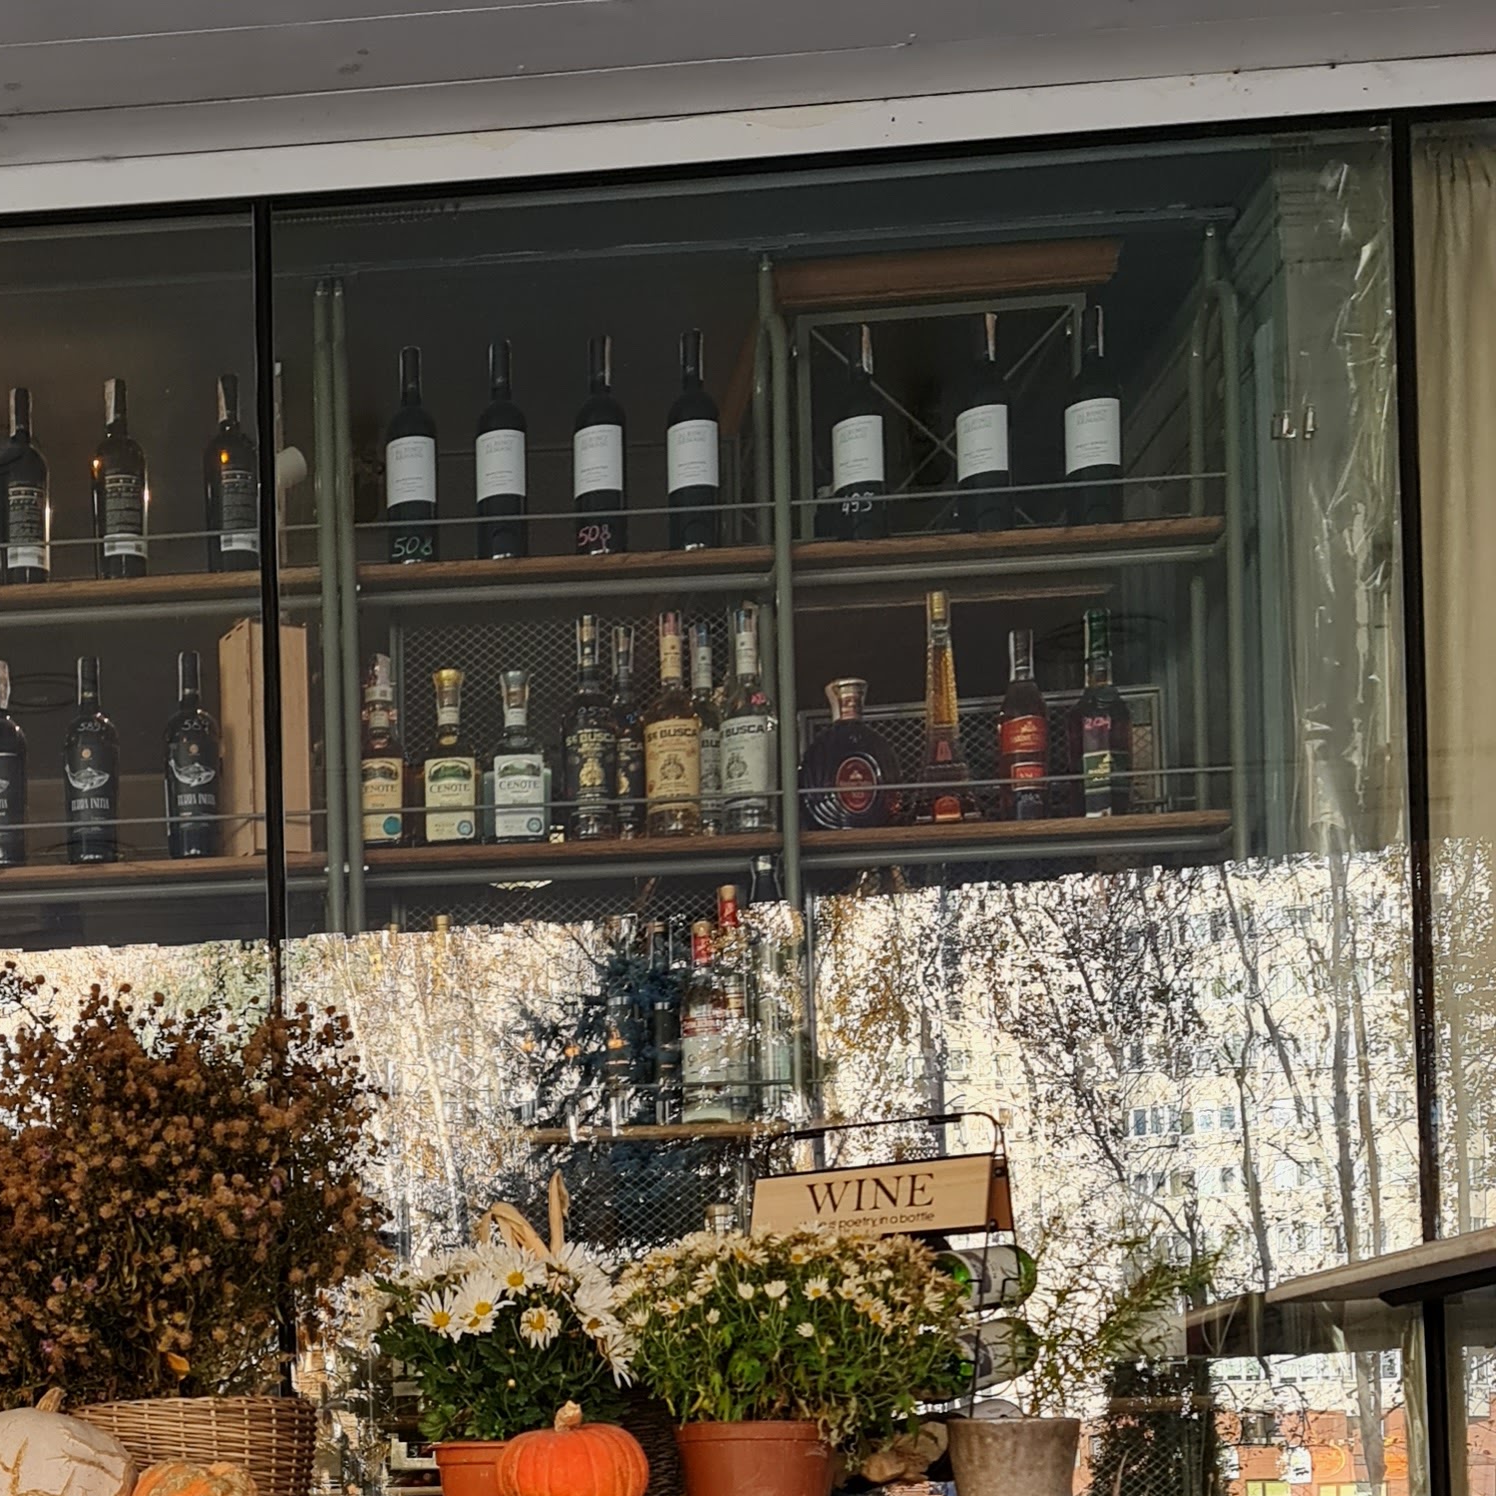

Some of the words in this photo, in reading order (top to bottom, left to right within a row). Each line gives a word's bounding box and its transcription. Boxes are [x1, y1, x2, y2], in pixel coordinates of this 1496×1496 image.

[363, 784, 397, 793] ENOTE
[429, 784, 471, 793] CENOTE
[499, 780, 540, 790] CENOTE
[807, 1173, 934, 1214] WINE
[839, 1216, 876, 1228] poetry
[900, 1211, 935, 1223] bottle
